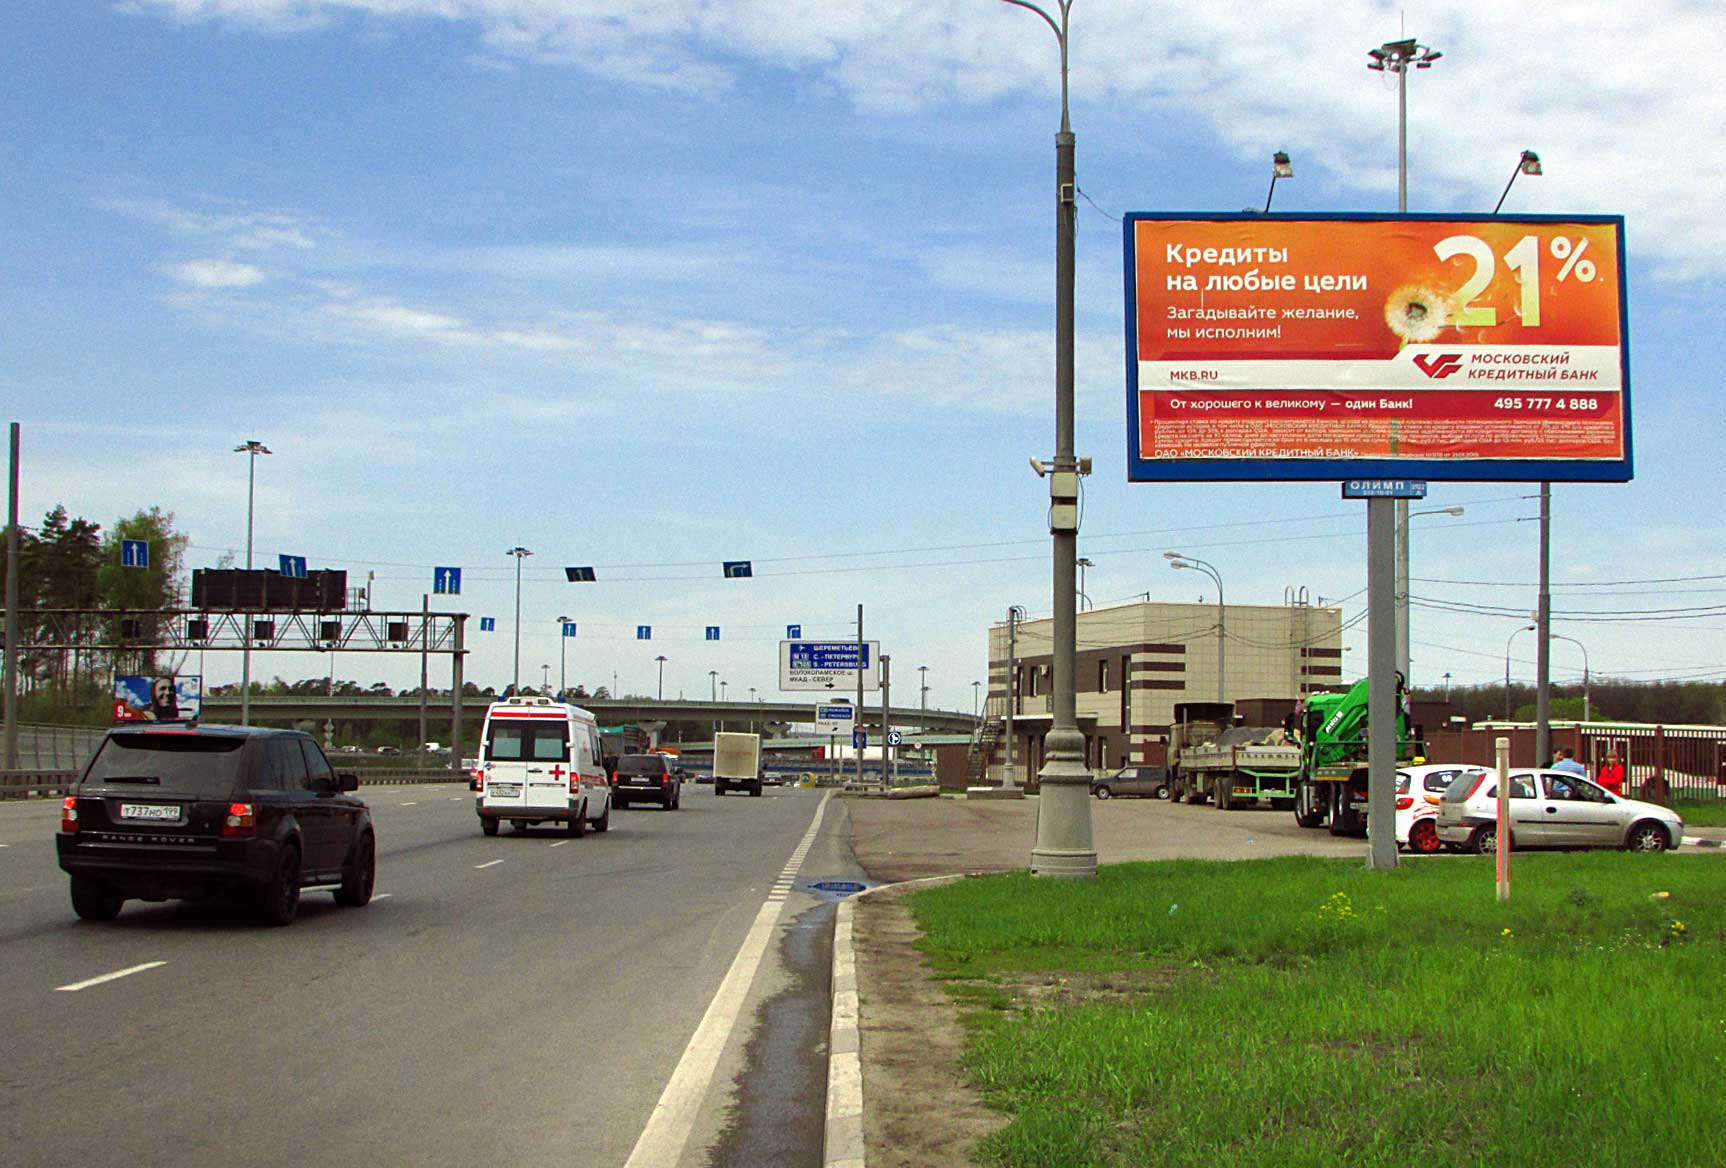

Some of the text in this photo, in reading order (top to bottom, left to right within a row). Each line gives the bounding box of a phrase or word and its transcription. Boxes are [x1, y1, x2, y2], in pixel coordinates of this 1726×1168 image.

[1166, 243, 1288, 268] Кредиты
[1166, 268, 1368, 293] на любые цели
[1167, 305, 1359, 320] Загадывайте желание,
[1167, 325, 1281, 338] мы исполним!
[1471, 351, 1570, 365] МОСКОВСКИЙ
[1170, 370, 1219, 381] MKB.RU
[1468, 367, 1598, 381] КРЕДИТНЫЙ БАНК
[1170, 399, 1187, 409] От
[1190, 400, 1251, 411] хорошего
[1254, 400, 1262, 409] к
[1265, 400, 1326, 411] великому
[1345, 399, 1377, 410] один
[1379, 398, 1413, 409] Банк!
[1494, 398, 1598, 410] 495 777 4 888
[1154, 449, 1178, 458] ОАО
[1258, 447, 1324, 458] КРЕДИТНЫЙ
[1350, 481, 1404, 490] ОЛИМП
[151, 836, 196, 844] ROVER
